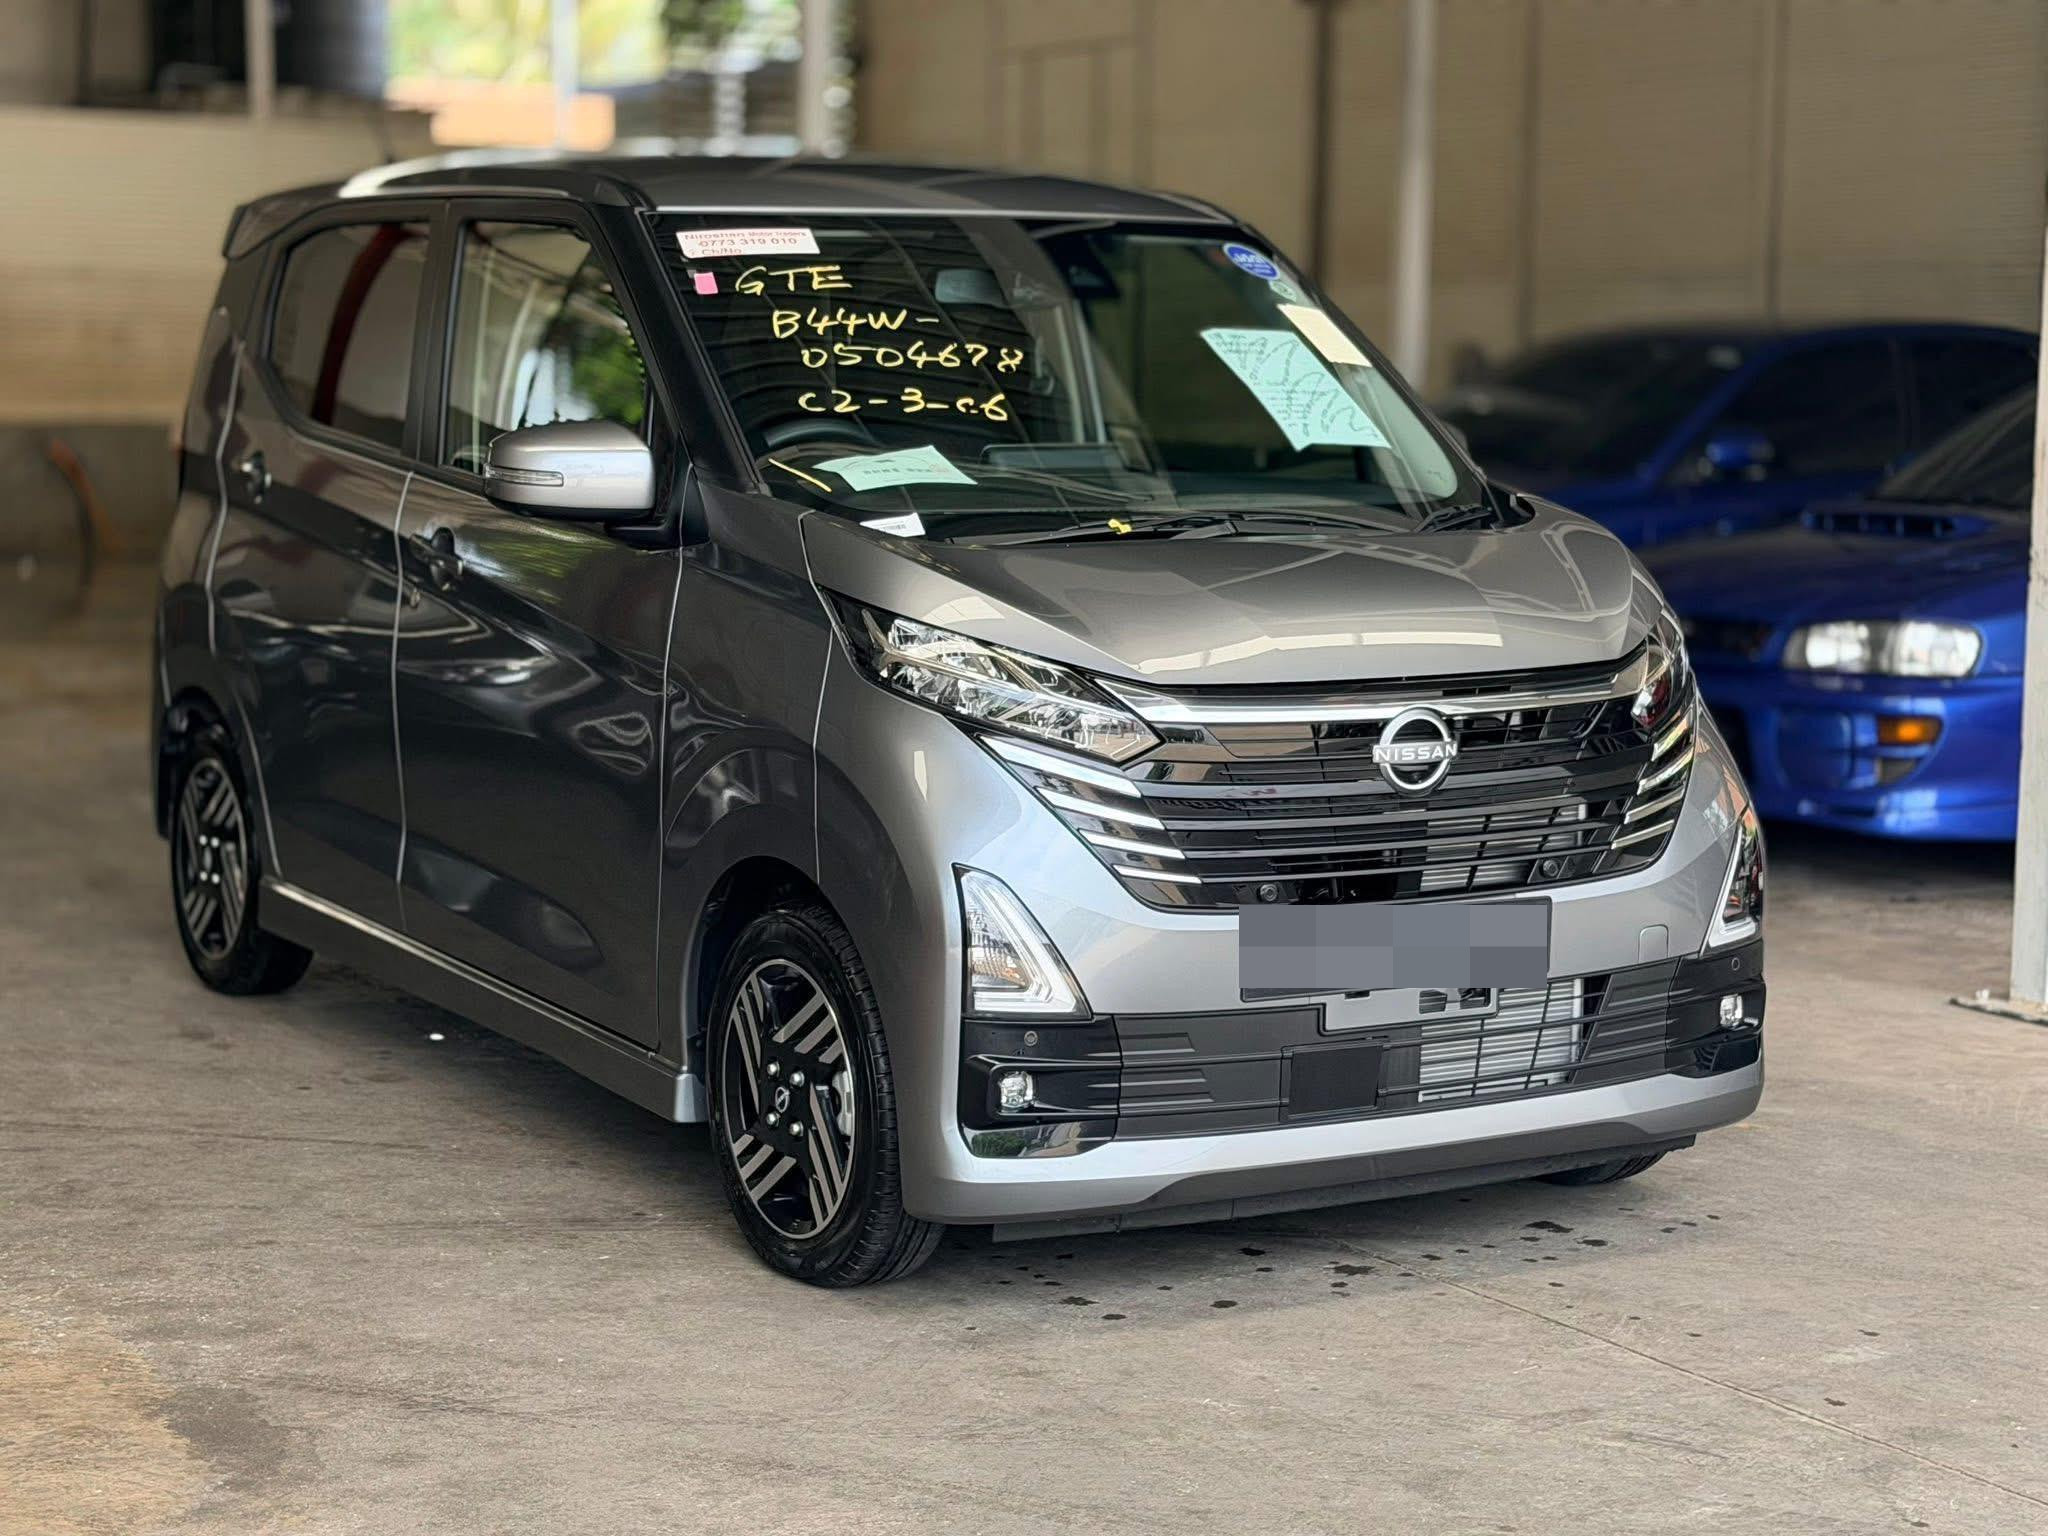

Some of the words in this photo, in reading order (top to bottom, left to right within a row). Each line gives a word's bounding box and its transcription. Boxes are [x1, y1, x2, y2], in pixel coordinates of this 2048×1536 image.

[699, 239, 736, 248] 0773
[771, 237, 798, 246] 010
[735, 265, 853, 296] GTE
[801, 341, 1024, 373] 0504678
[1375, 743, 1457, 762] NISSAN
